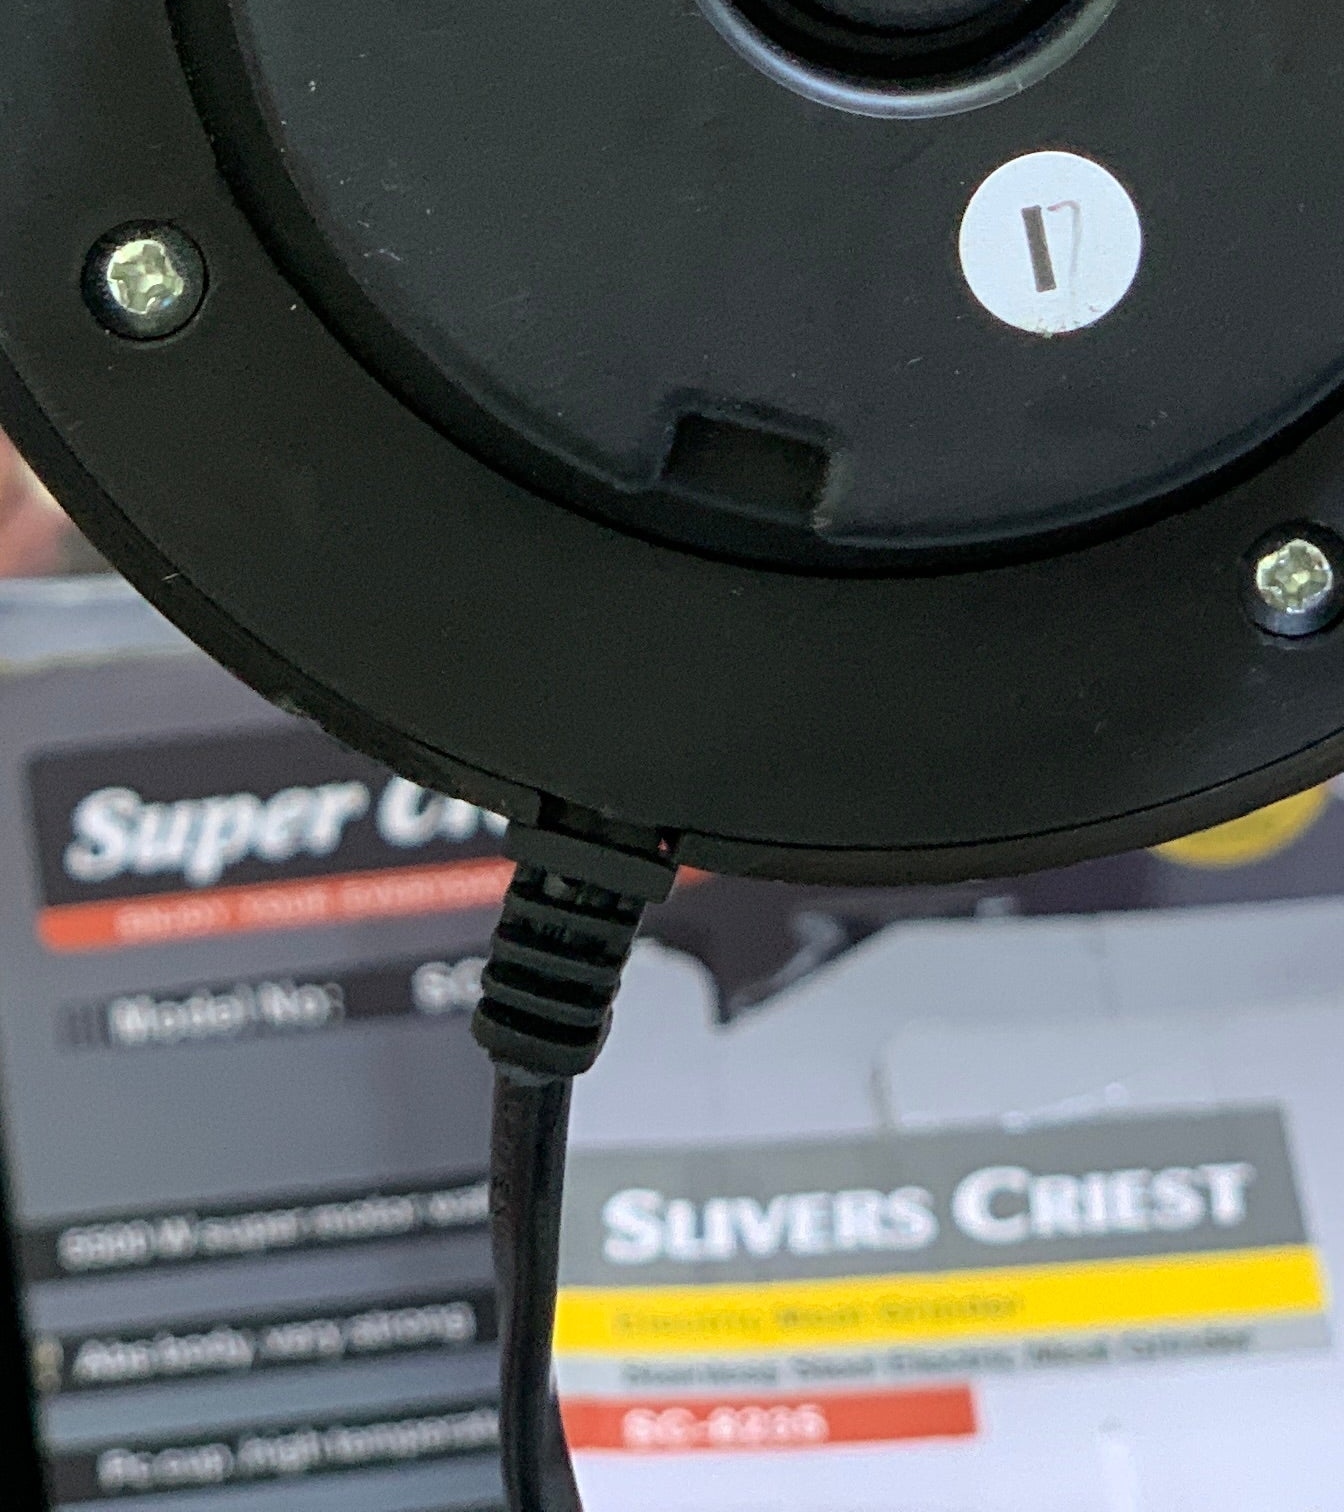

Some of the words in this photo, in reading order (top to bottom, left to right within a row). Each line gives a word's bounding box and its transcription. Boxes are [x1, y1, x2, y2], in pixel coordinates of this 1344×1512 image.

[62, 780, 370, 888] Super
[106, 981, 255, 1048] Model
[601, 1185, 940, 1266] SLIVERS
[950, 1160, 1256, 1246] CRIEST
